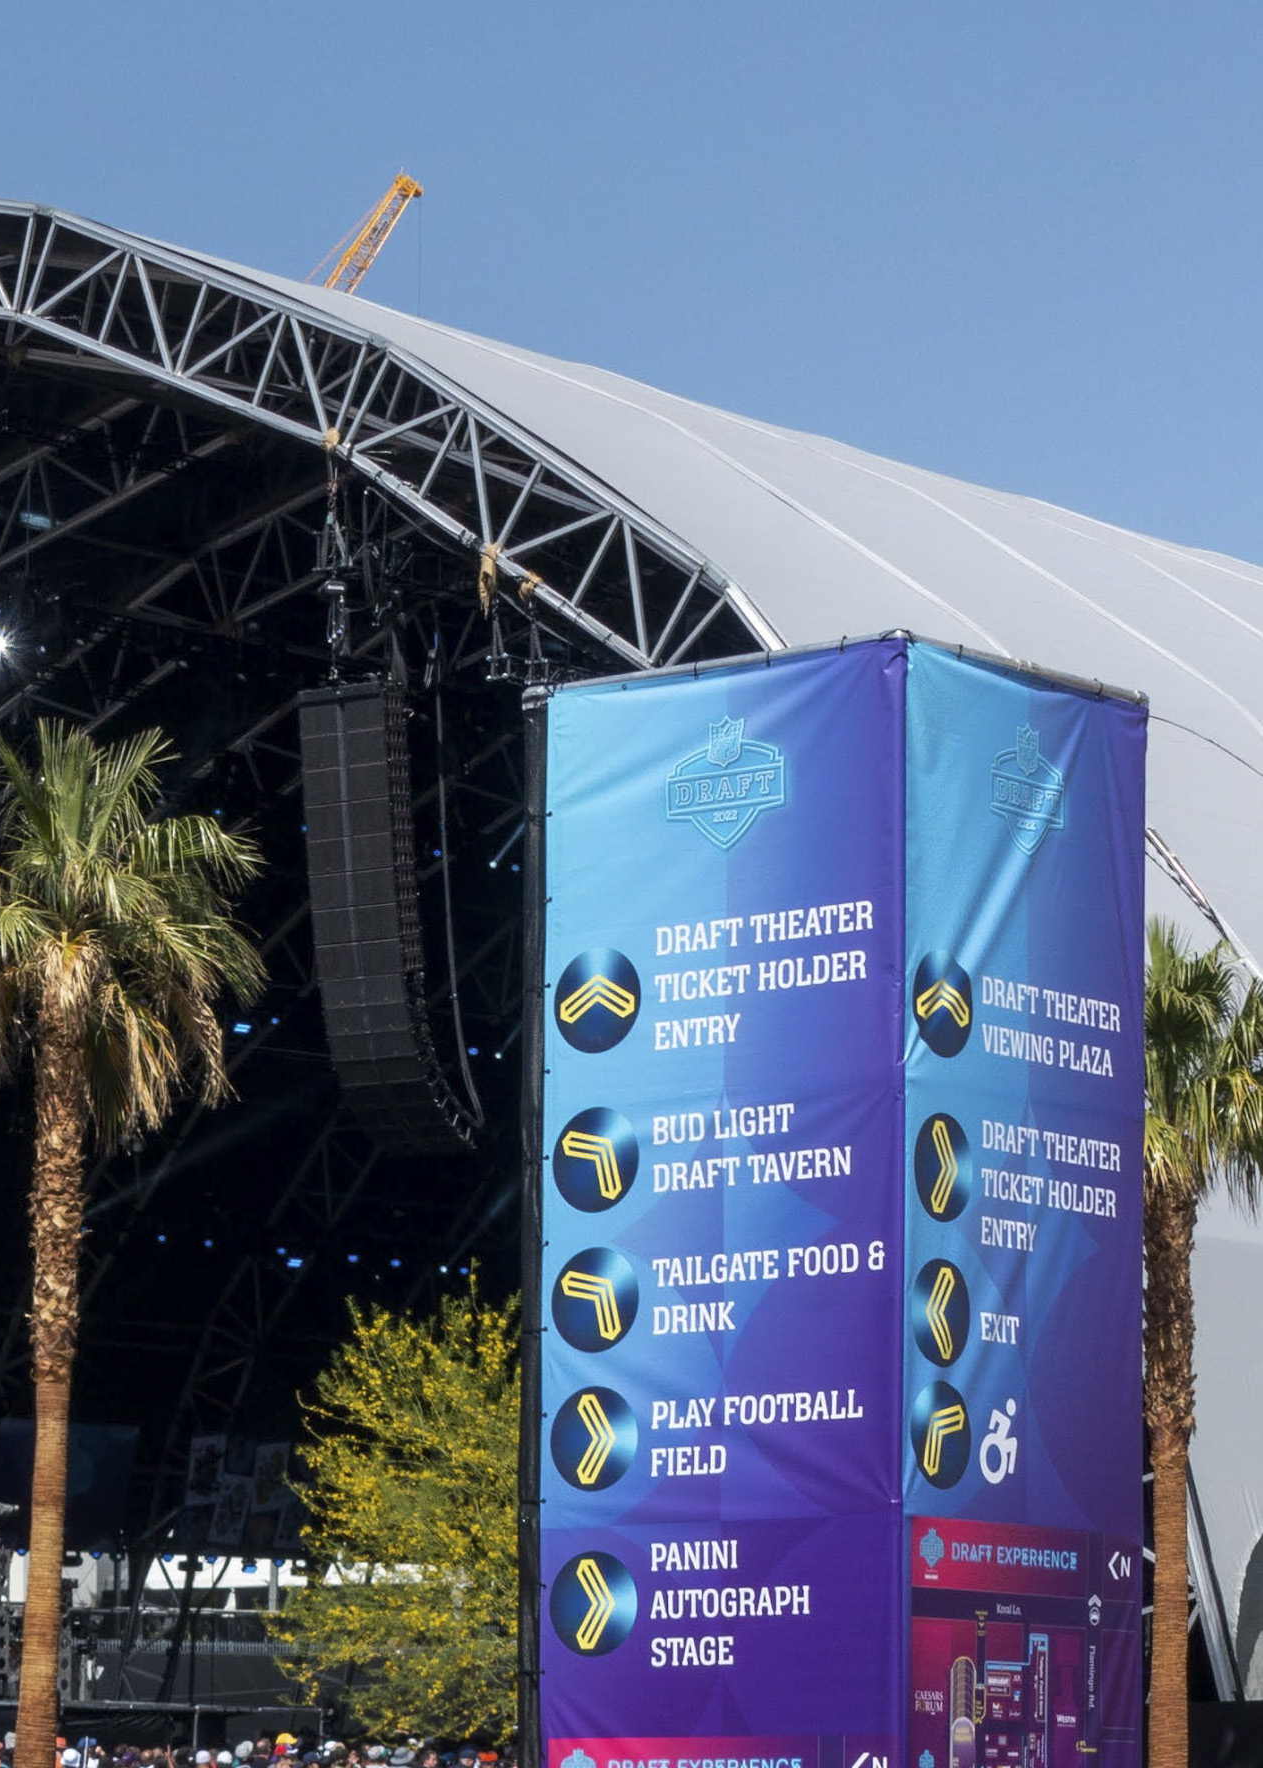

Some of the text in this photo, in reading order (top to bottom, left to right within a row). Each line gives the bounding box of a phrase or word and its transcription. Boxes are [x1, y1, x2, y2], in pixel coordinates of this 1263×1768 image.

[675, 770, 774, 806] DRAFT
[713, 810, 737, 822] 2022
[656, 901, 873, 956] DRAFT THEATER
[655, 950, 867, 1003] TICKET HOLDER
[982, 977, 1120, 1032] DRAFT THEATER
[654, 1014, 740, 1051] ENTRY
[982, 1026, 1114, 1077] VIEWING PLAZA
[652, 1103, 794, 1145] BUD LIGHT
[982, 1121, 1120, 1171] DRAFT THEATER
[653, 1146, 852, 1192] DRAFT TAVERN
[982, 1169, 1117, 1218] TICKET HOLDER
[981, 1216, 1037, 1252] ENTRY
[653, 1241, 885, 1288] TAILGATE FOOD &
[653, 1302, 735, 1335] DRINK
[980, 1312, 1019, 1345] EXIT
[651, 1390, 863, 1430] PLAY FOOTBALL
[651, 1445, 726, 1477] FIELD
[651, 1540, 738, 1571] PANINI
[952, 1542, 1077, 1571] DRAFT EXPERIENCE
[1120, 1556, 1131, 1578] N
[650, 1586, 810, 1619] AUTOGRAPH
[996, 1603, 1011, 1614] Koval
[651, 1637, 734, 1667] STAGE
[1088, 1645, 1096, 1692] Flamingo
[915, 1690, 943, 1700] CAESARS
[915, 1701, 943, 1712] FRUM
